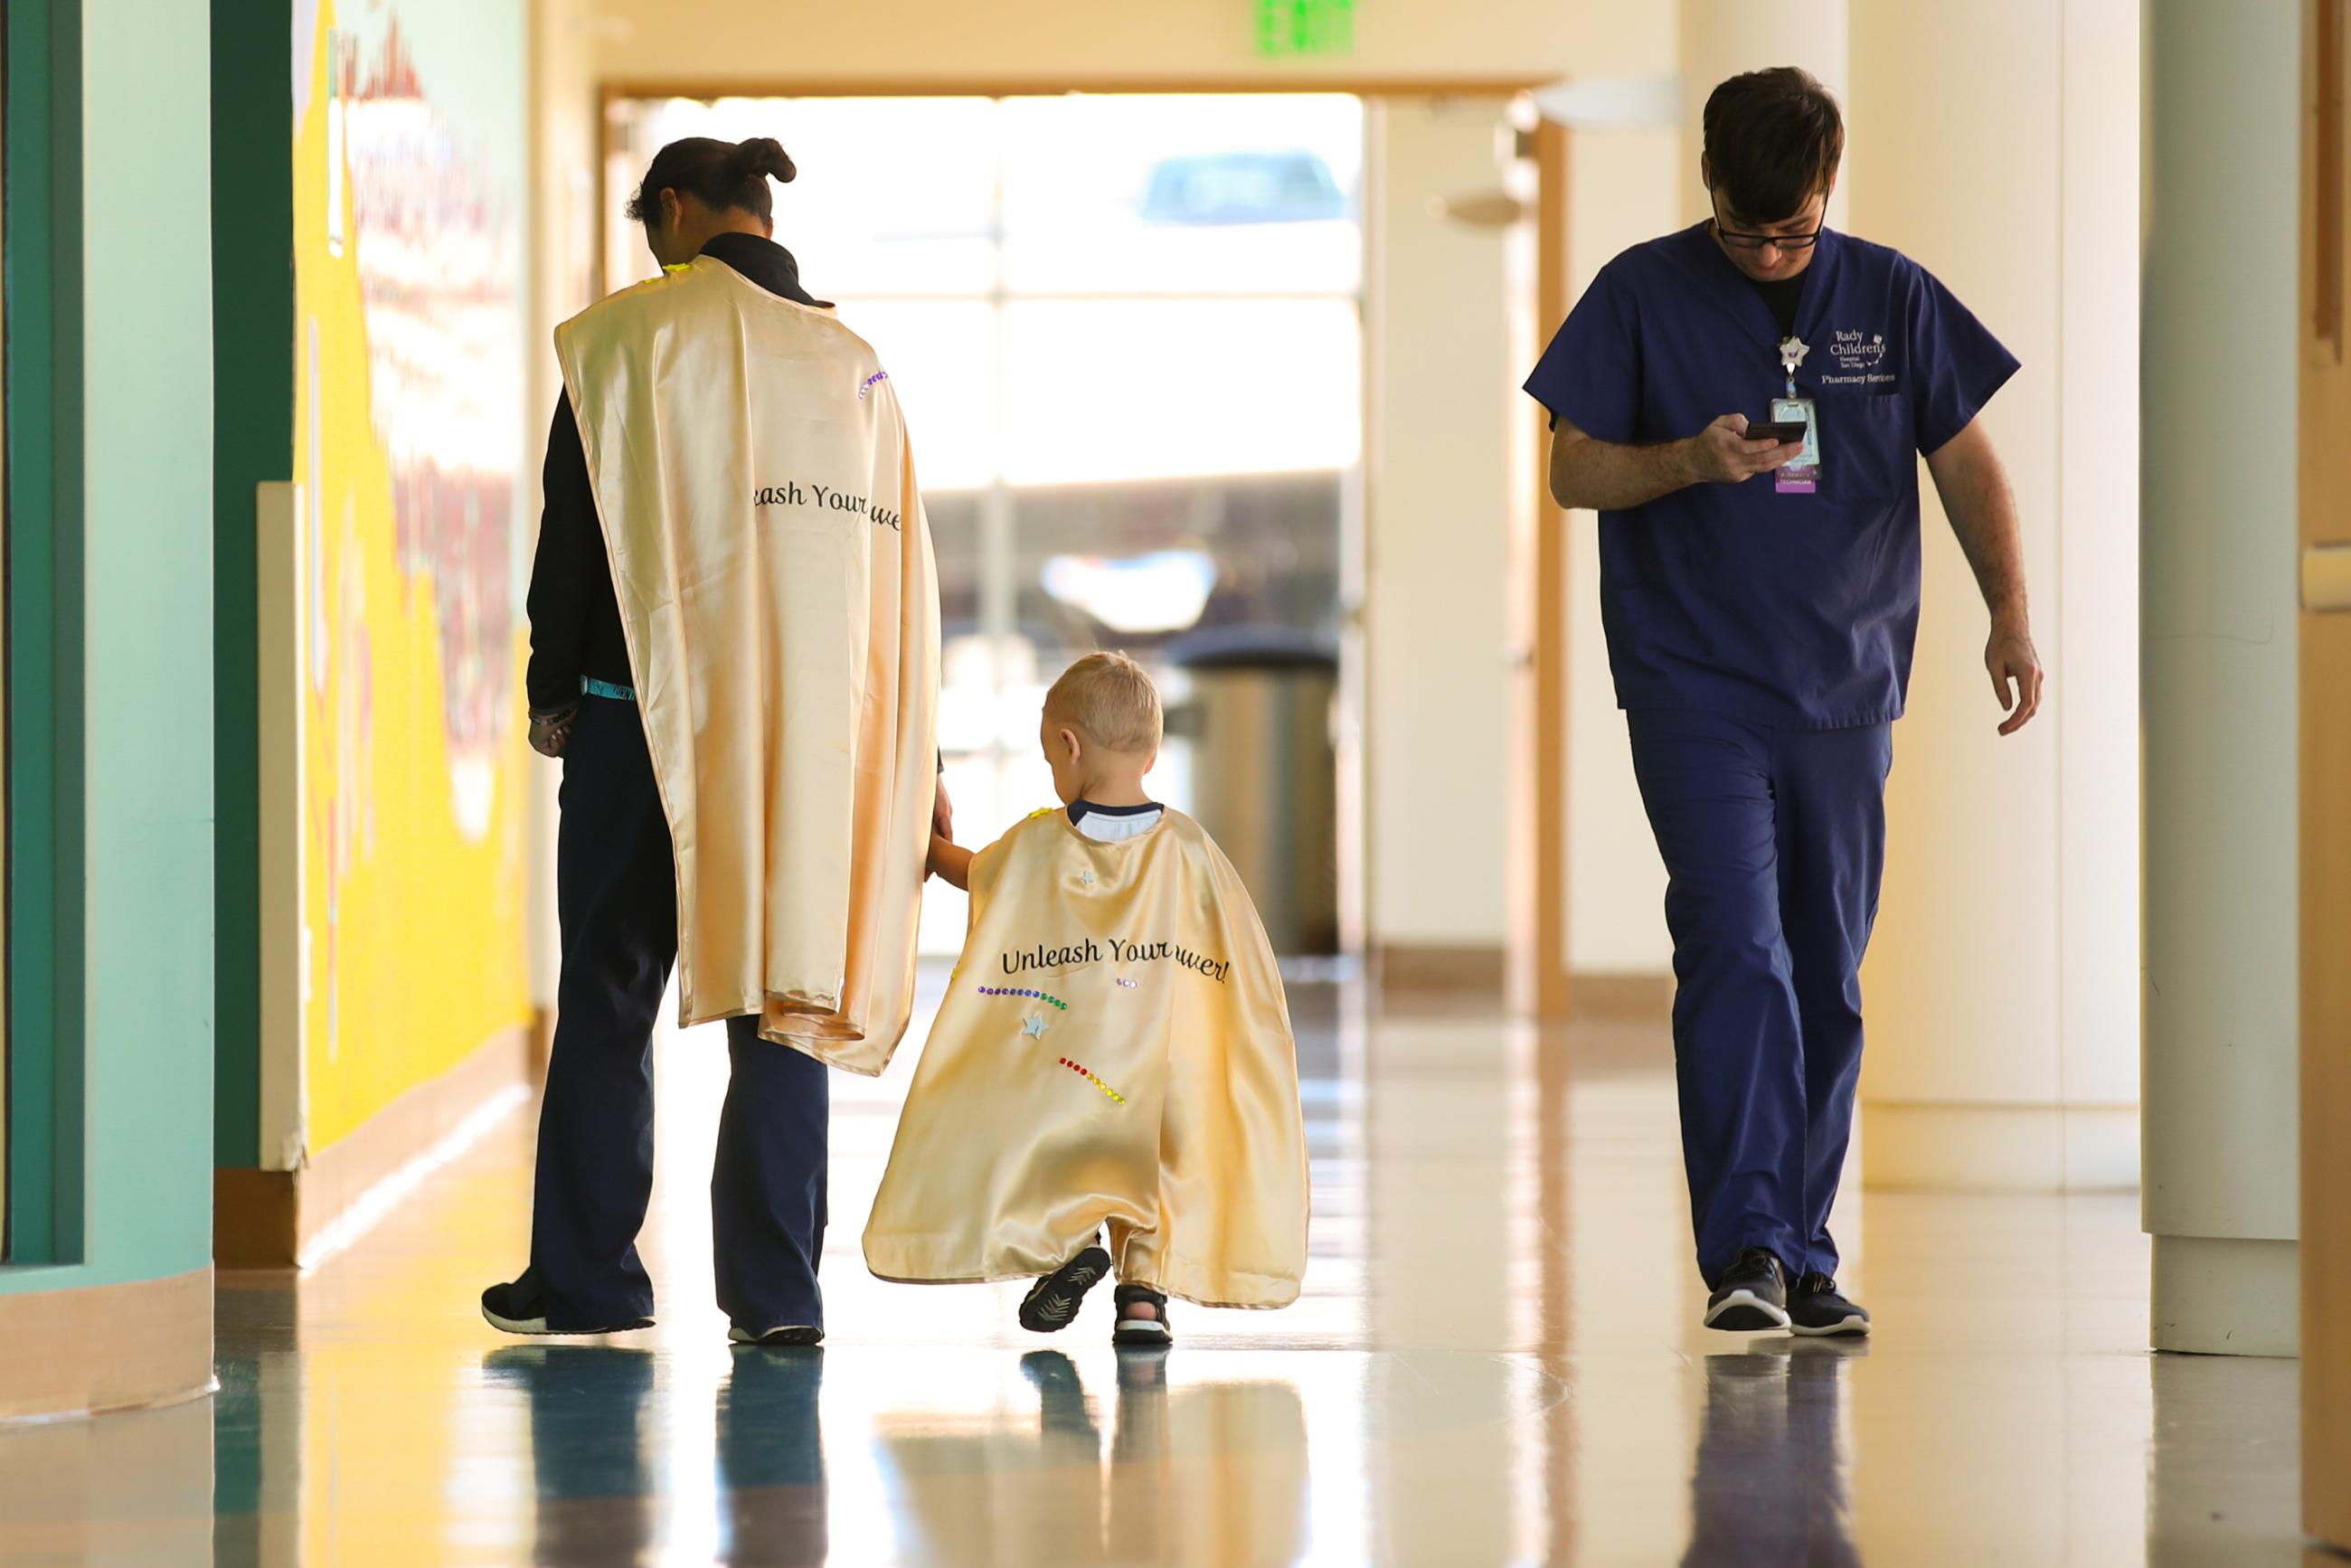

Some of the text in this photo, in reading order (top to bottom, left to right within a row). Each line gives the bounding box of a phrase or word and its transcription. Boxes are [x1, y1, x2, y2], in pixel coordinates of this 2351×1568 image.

[1836, 329, 1863, 345] Rady
[1821, 375, 1865, 384] Pharmacy
[811, 485, 868, 514] Your
[1002, 938, 1104, 975] Unleash
[1108, 939, 1174, 963] Your
